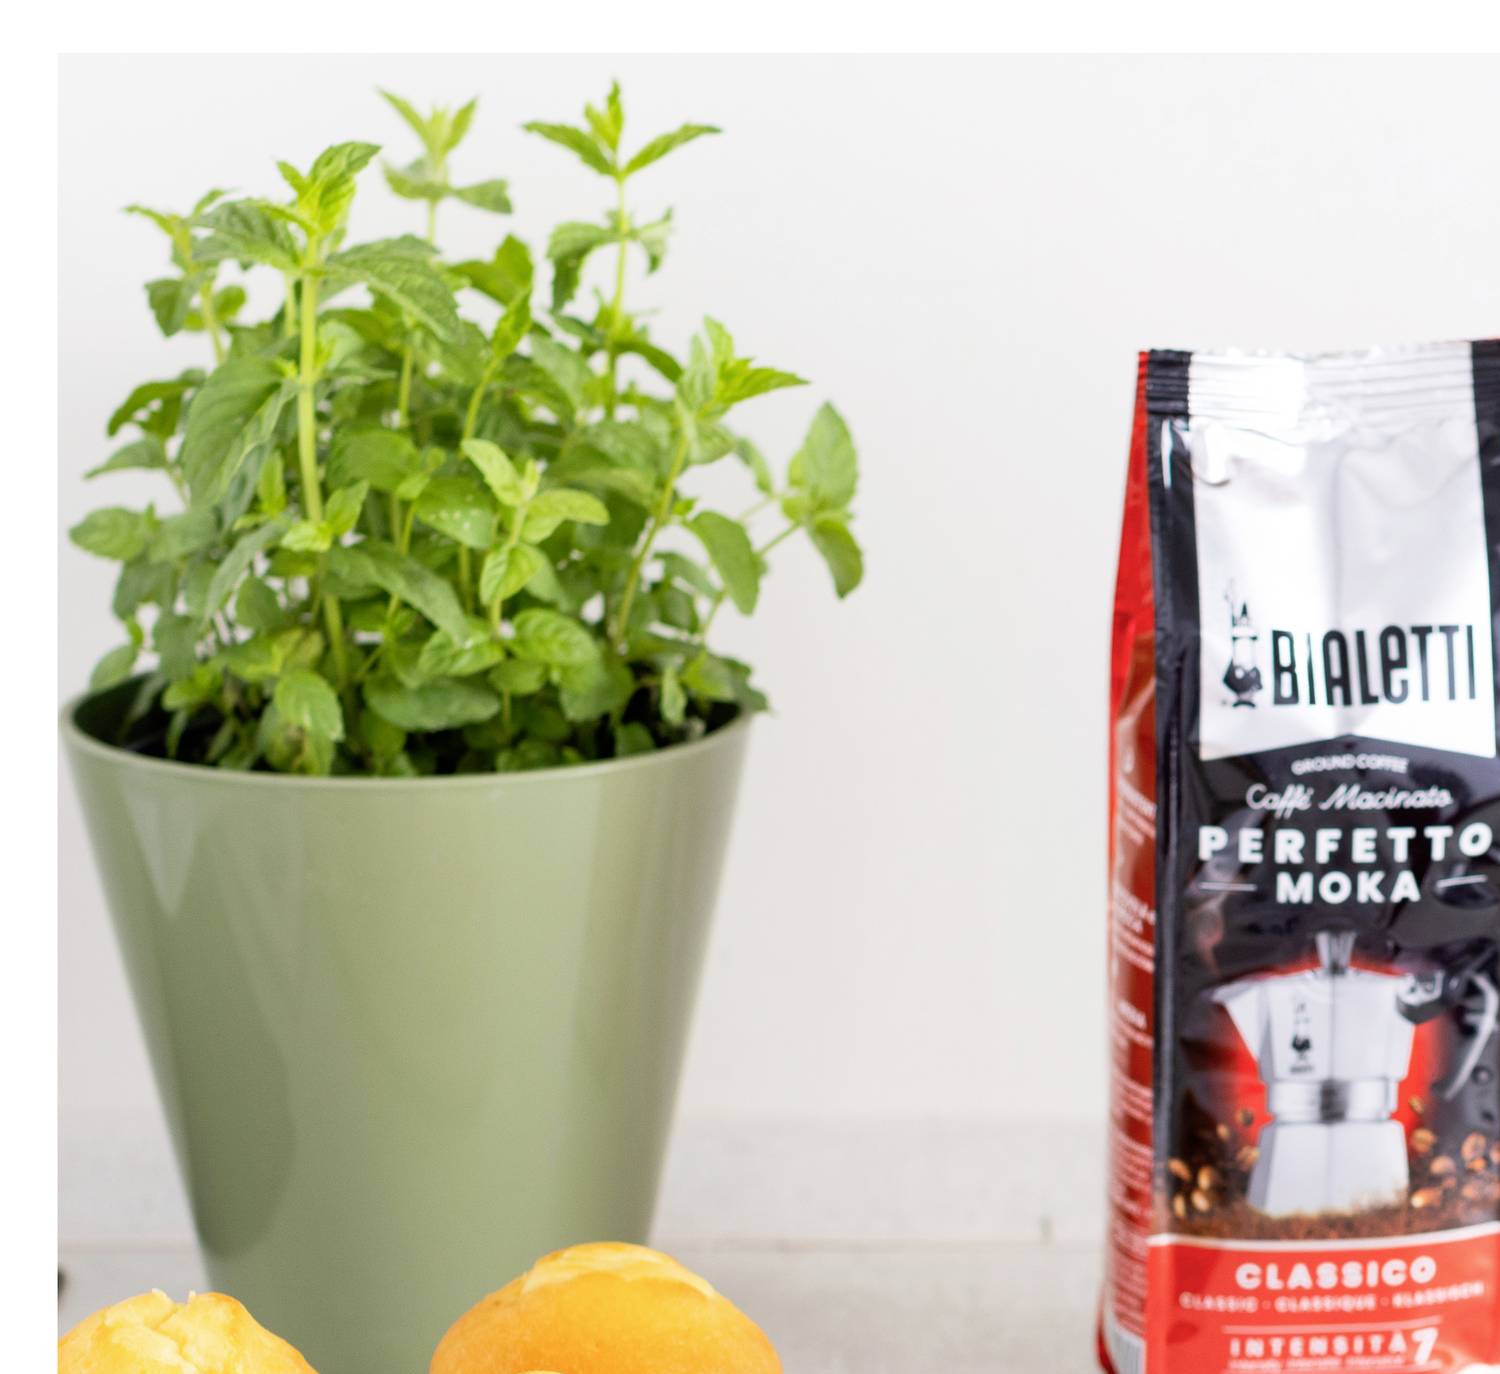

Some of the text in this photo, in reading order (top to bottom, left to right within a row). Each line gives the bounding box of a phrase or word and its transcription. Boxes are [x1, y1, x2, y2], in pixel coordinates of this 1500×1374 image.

[1291, 754, 1410, 775] GROUND COFFEE
[1318, 783, 1454, 810] Macinato
[1199, 822, 1493, 865] PERFETTO
[1276, 870, 1421, 904] MOKA
[1235, 1255, 1437, 1290] CLASSICO
[1411, 1327, 1439, 1365] 7
